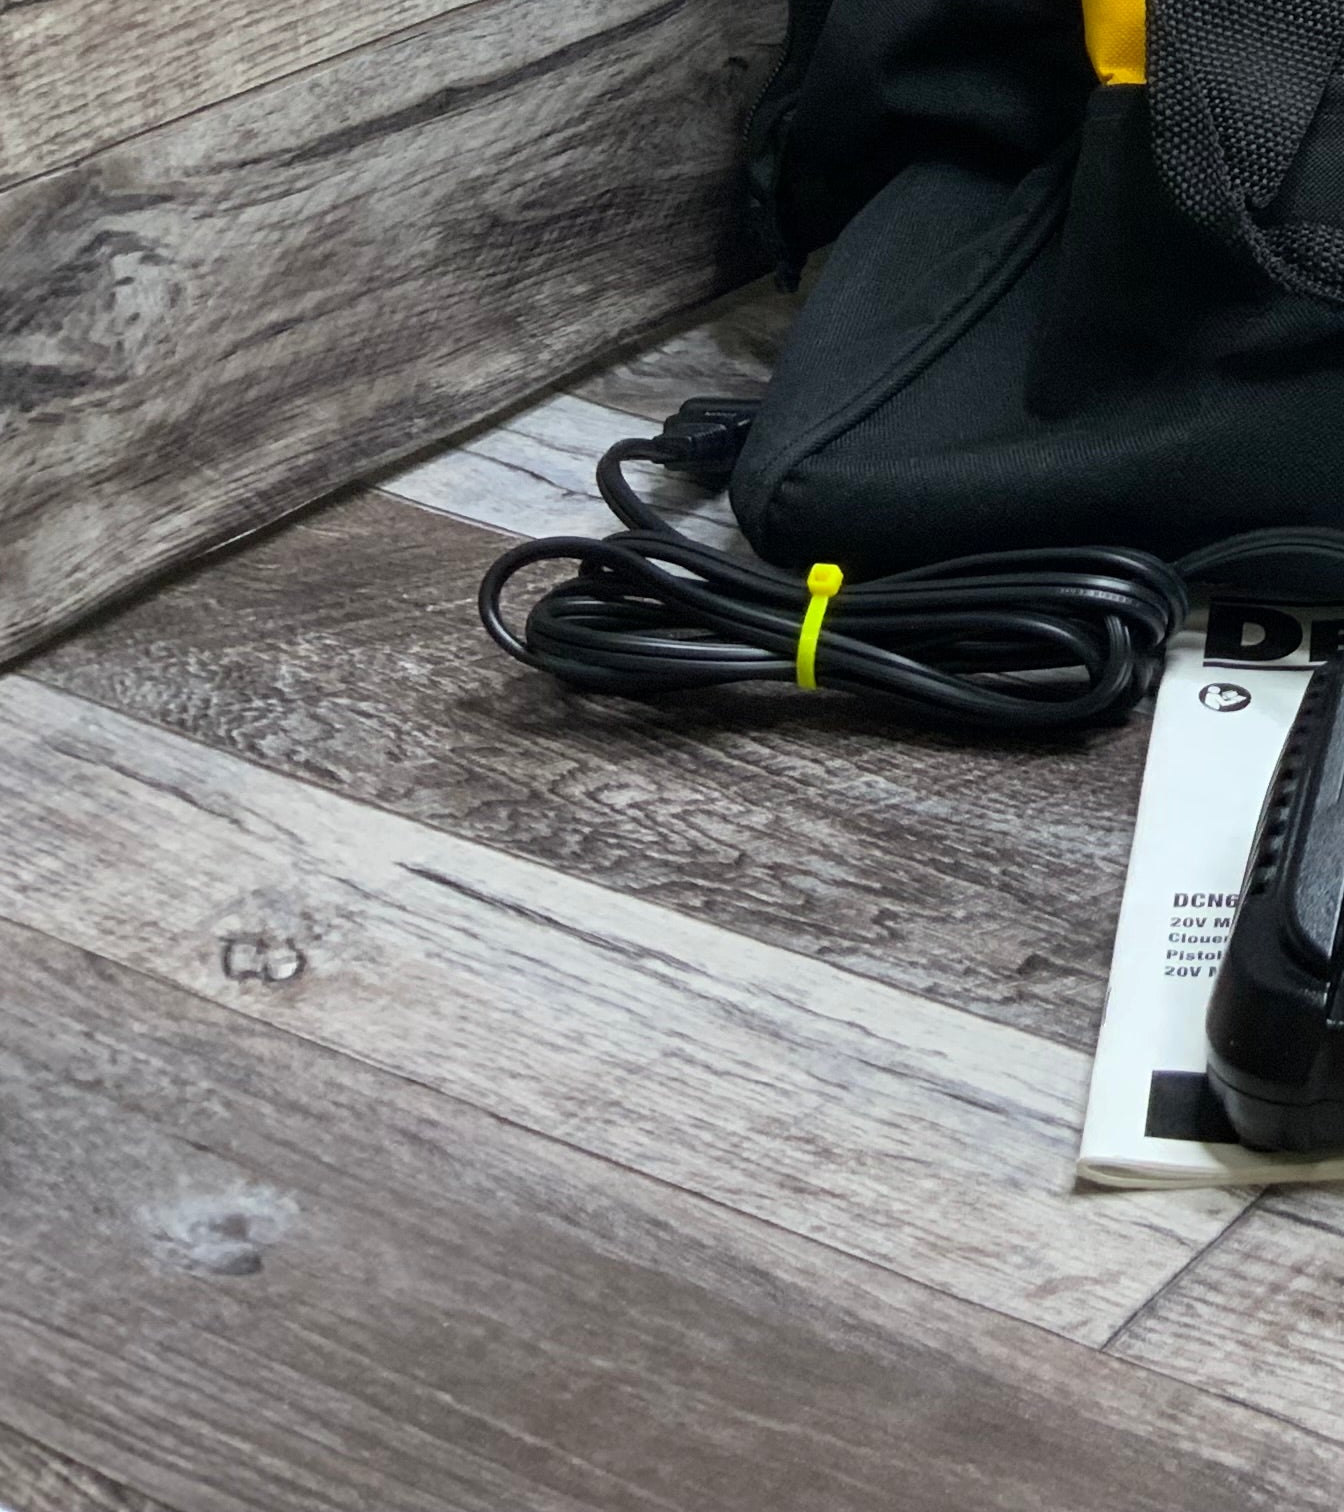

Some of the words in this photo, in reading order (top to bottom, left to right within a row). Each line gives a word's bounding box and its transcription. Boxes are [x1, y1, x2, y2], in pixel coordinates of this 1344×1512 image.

[1173, 892, 1240, 908] DCN6
[1169, 917, 1207, 928] 20V
[1166, 950, 1222, 961] Pistol
[1164, 966, 1202, 977] 20V
